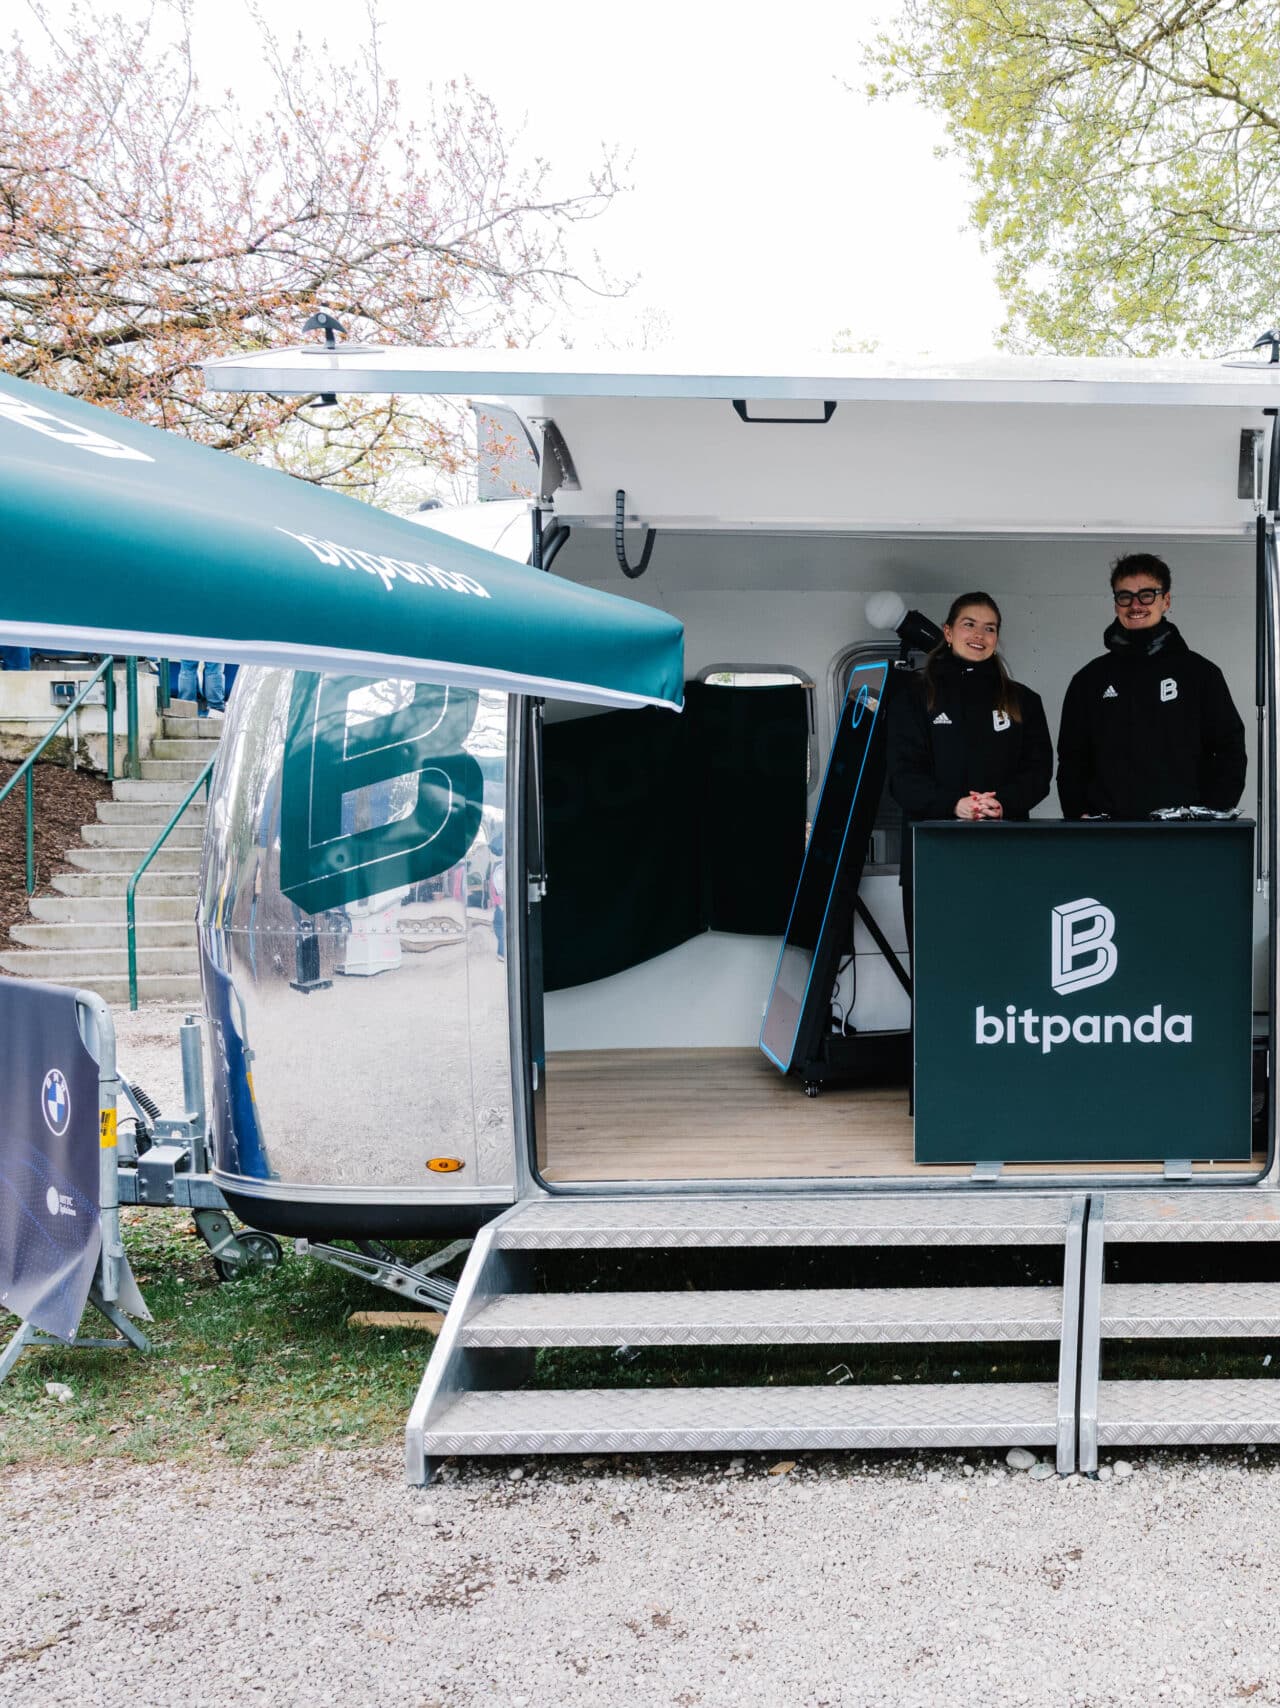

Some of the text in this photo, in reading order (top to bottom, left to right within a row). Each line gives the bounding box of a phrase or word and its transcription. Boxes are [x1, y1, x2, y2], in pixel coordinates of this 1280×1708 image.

[273, 526, 492, 598] bitpanda
[1160, 678, 1178, 702] B
[975, 1004, 1192, 1055] bitpanda
